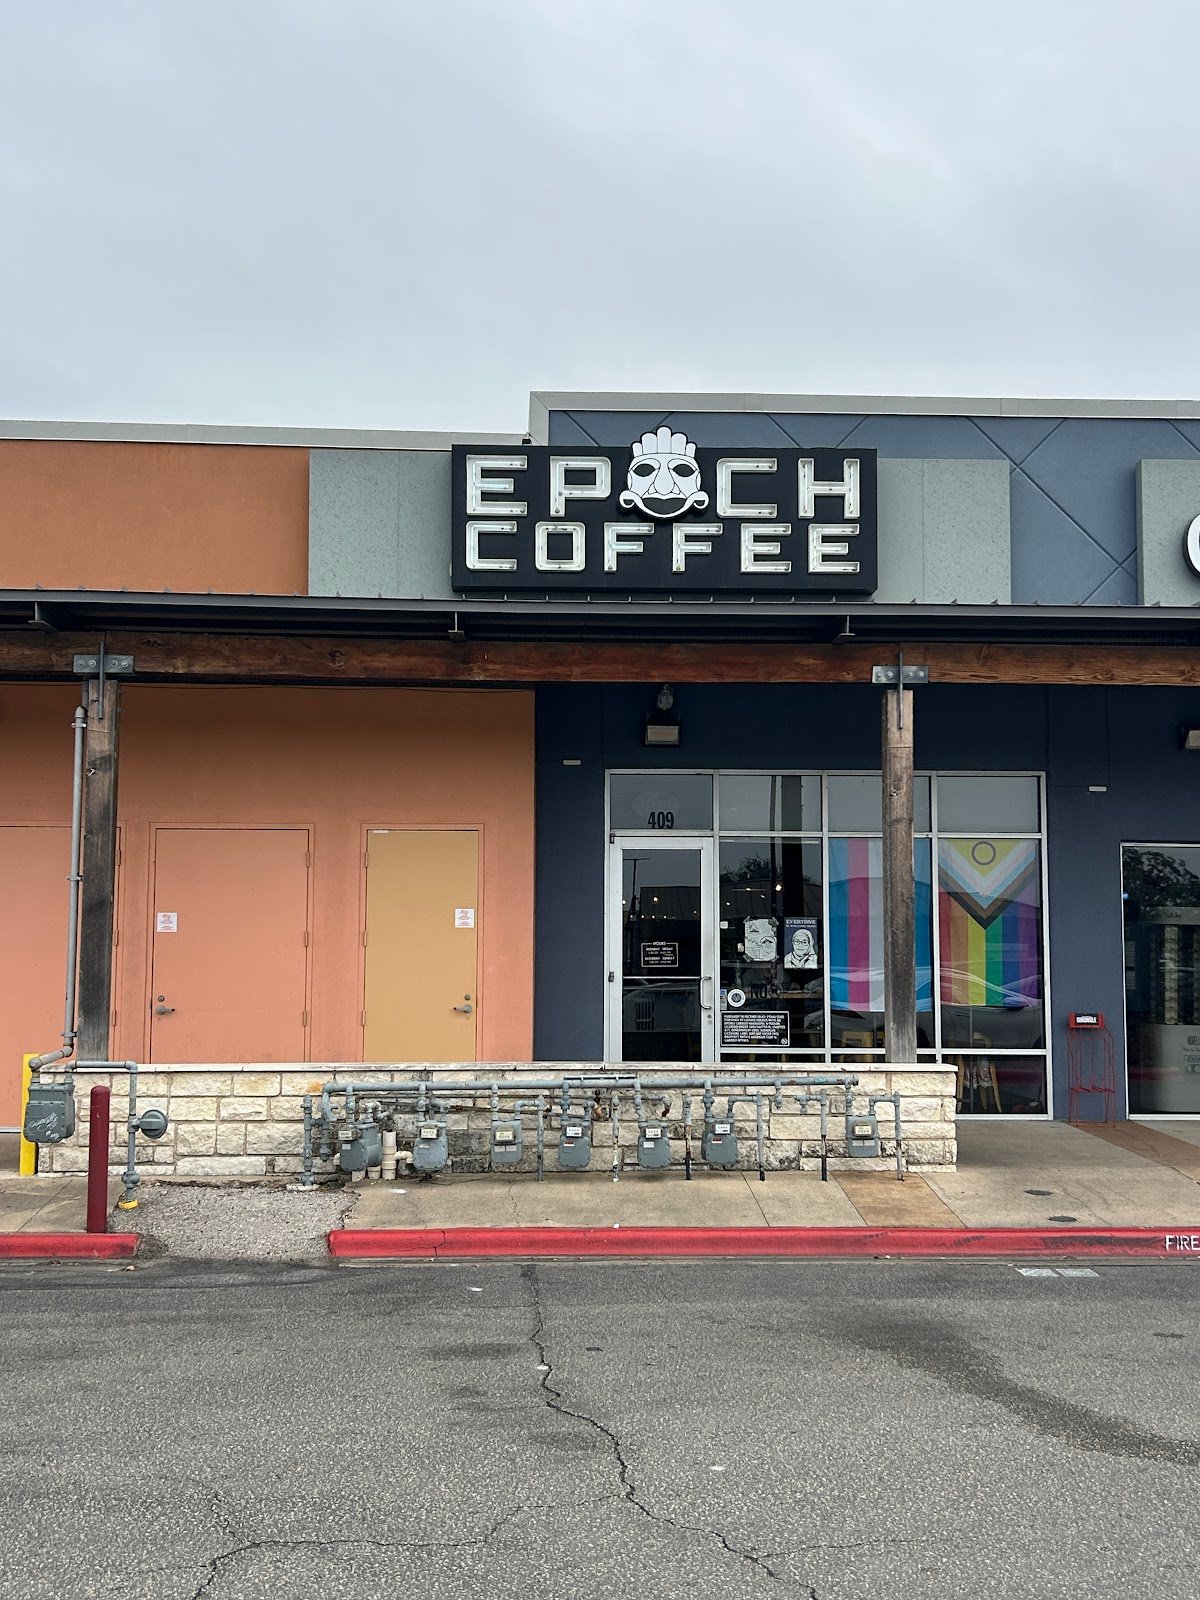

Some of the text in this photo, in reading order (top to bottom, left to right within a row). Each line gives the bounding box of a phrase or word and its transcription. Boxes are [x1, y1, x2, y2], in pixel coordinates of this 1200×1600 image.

[465, 454, 861, 520] EPCH
[465, 520, 861, 575] COFFEE
[647, 811, 675, 829] 409
[1165, 1234, 1200, 1251] FIRE
